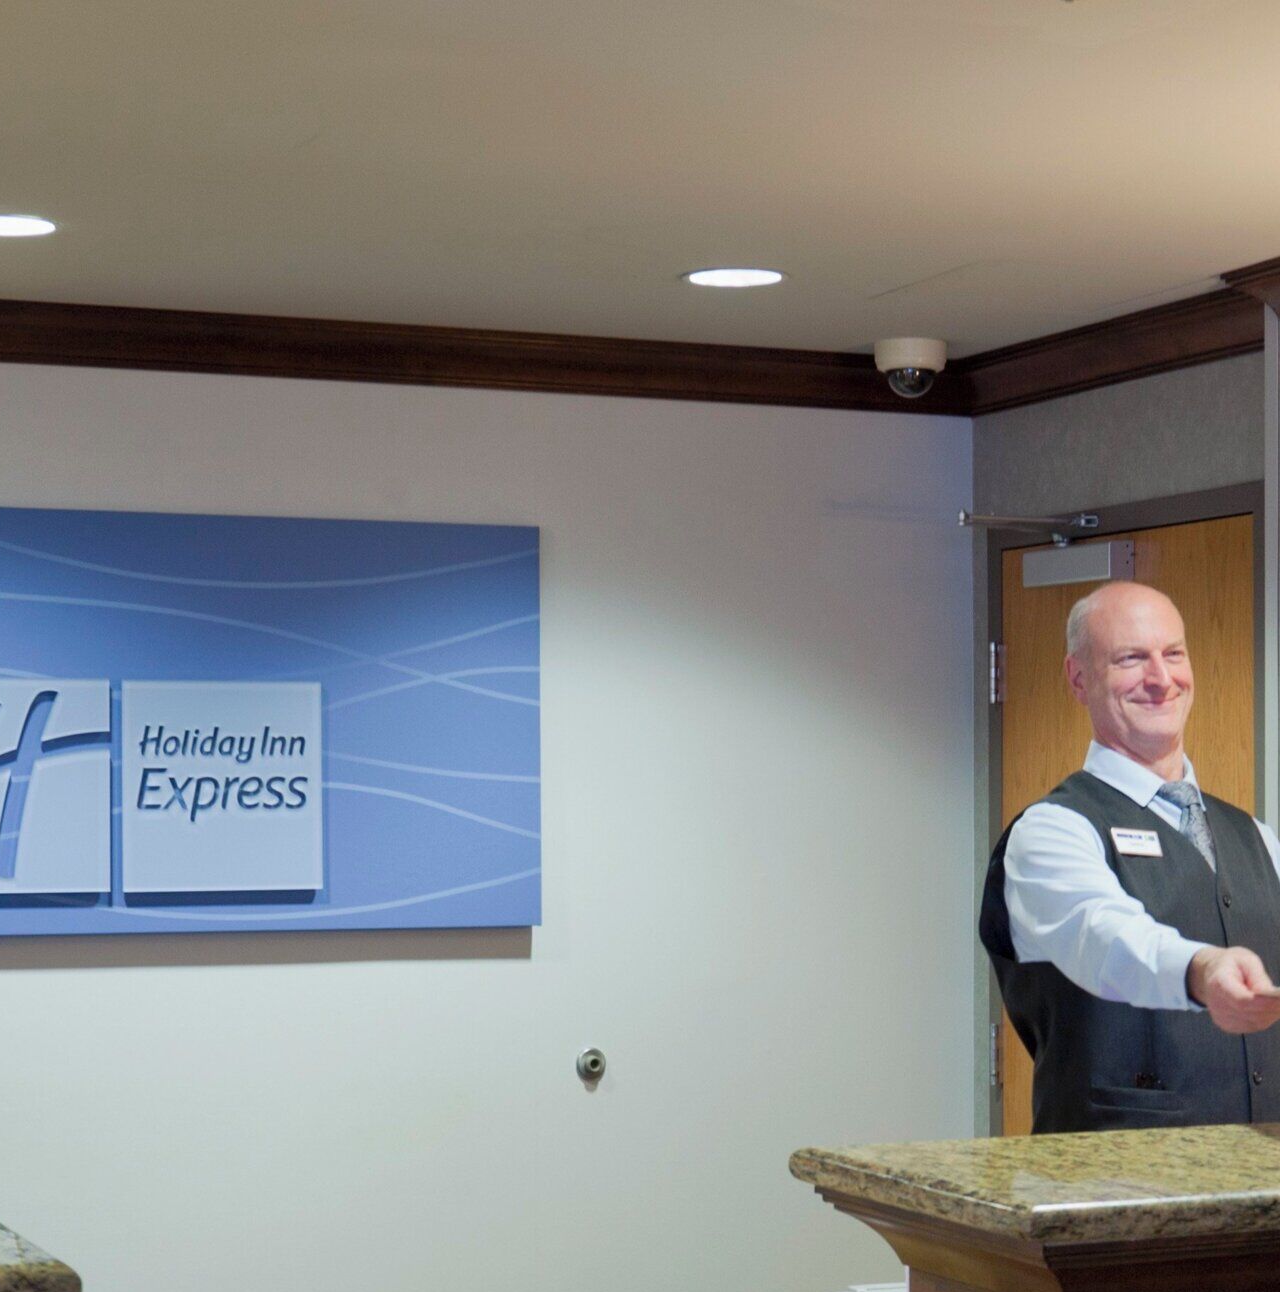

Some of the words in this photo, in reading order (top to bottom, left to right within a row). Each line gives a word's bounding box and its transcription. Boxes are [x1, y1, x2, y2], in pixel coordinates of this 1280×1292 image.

[139, 725, 256, 764] Holiday
[261, 726, 306, 756] Inn
[137, 768, 308, 823] Express
